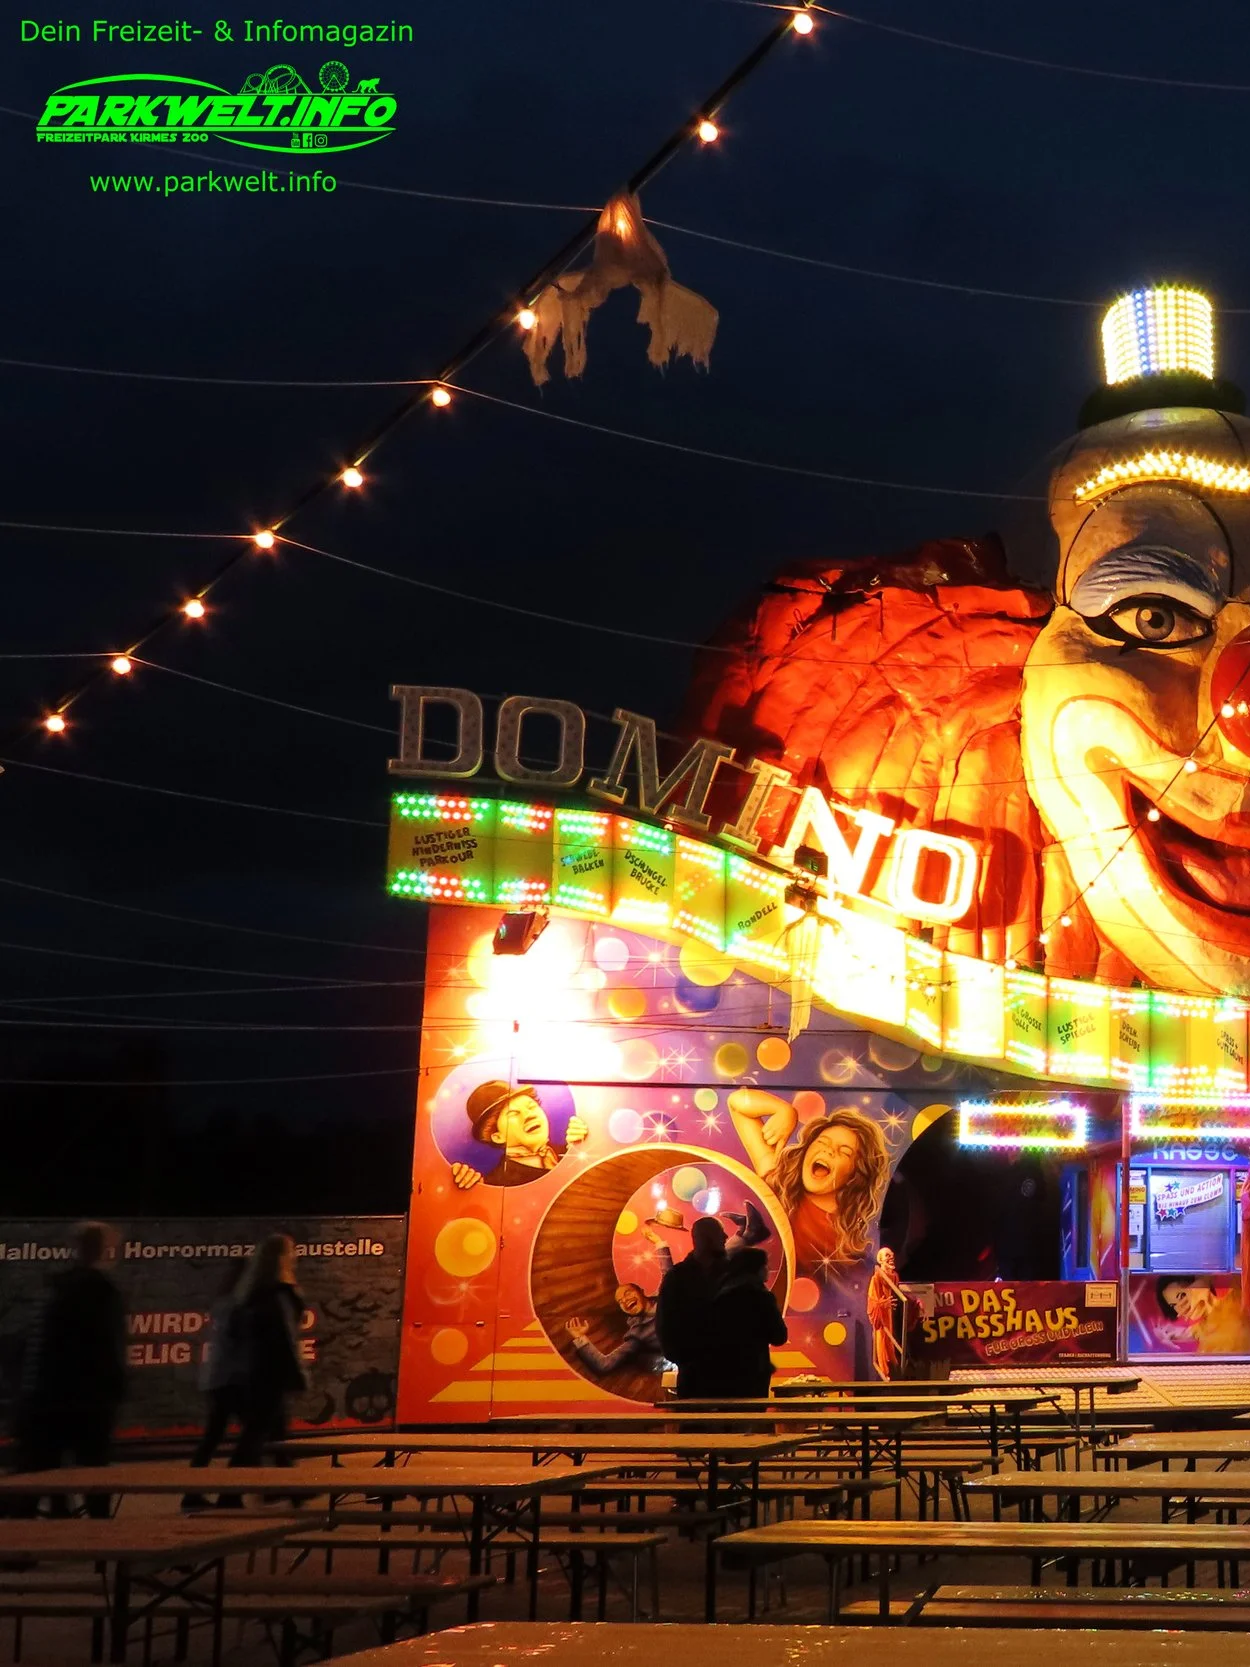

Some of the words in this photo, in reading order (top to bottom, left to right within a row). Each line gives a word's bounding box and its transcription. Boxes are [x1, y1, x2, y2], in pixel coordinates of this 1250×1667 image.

[388, 684, 978, 923] DOMINO
[414, 827, 471, 845] LUSTIGER
[572, 859, 605, 875] BALKEN
[738, 902, 778, 930] RONDELL
[1057, 1012, 1095, 1034] LUSTIGE
[1060, 1024, 1096, 1045] SPIEGEL
[1158, 1192, 1177, 1201] SPASS
[1180, 1187, 1194, 1197] UND
[1197, 1176, 1221, 1191] ACTION
[124, 1241, 256, 1259] Horrormaz
[295, 1238, 385, 1257] austelle
[960, 1288, 1018, 1314] DAS
[922, 1307, 1079, 1344] SPASSHAUS
